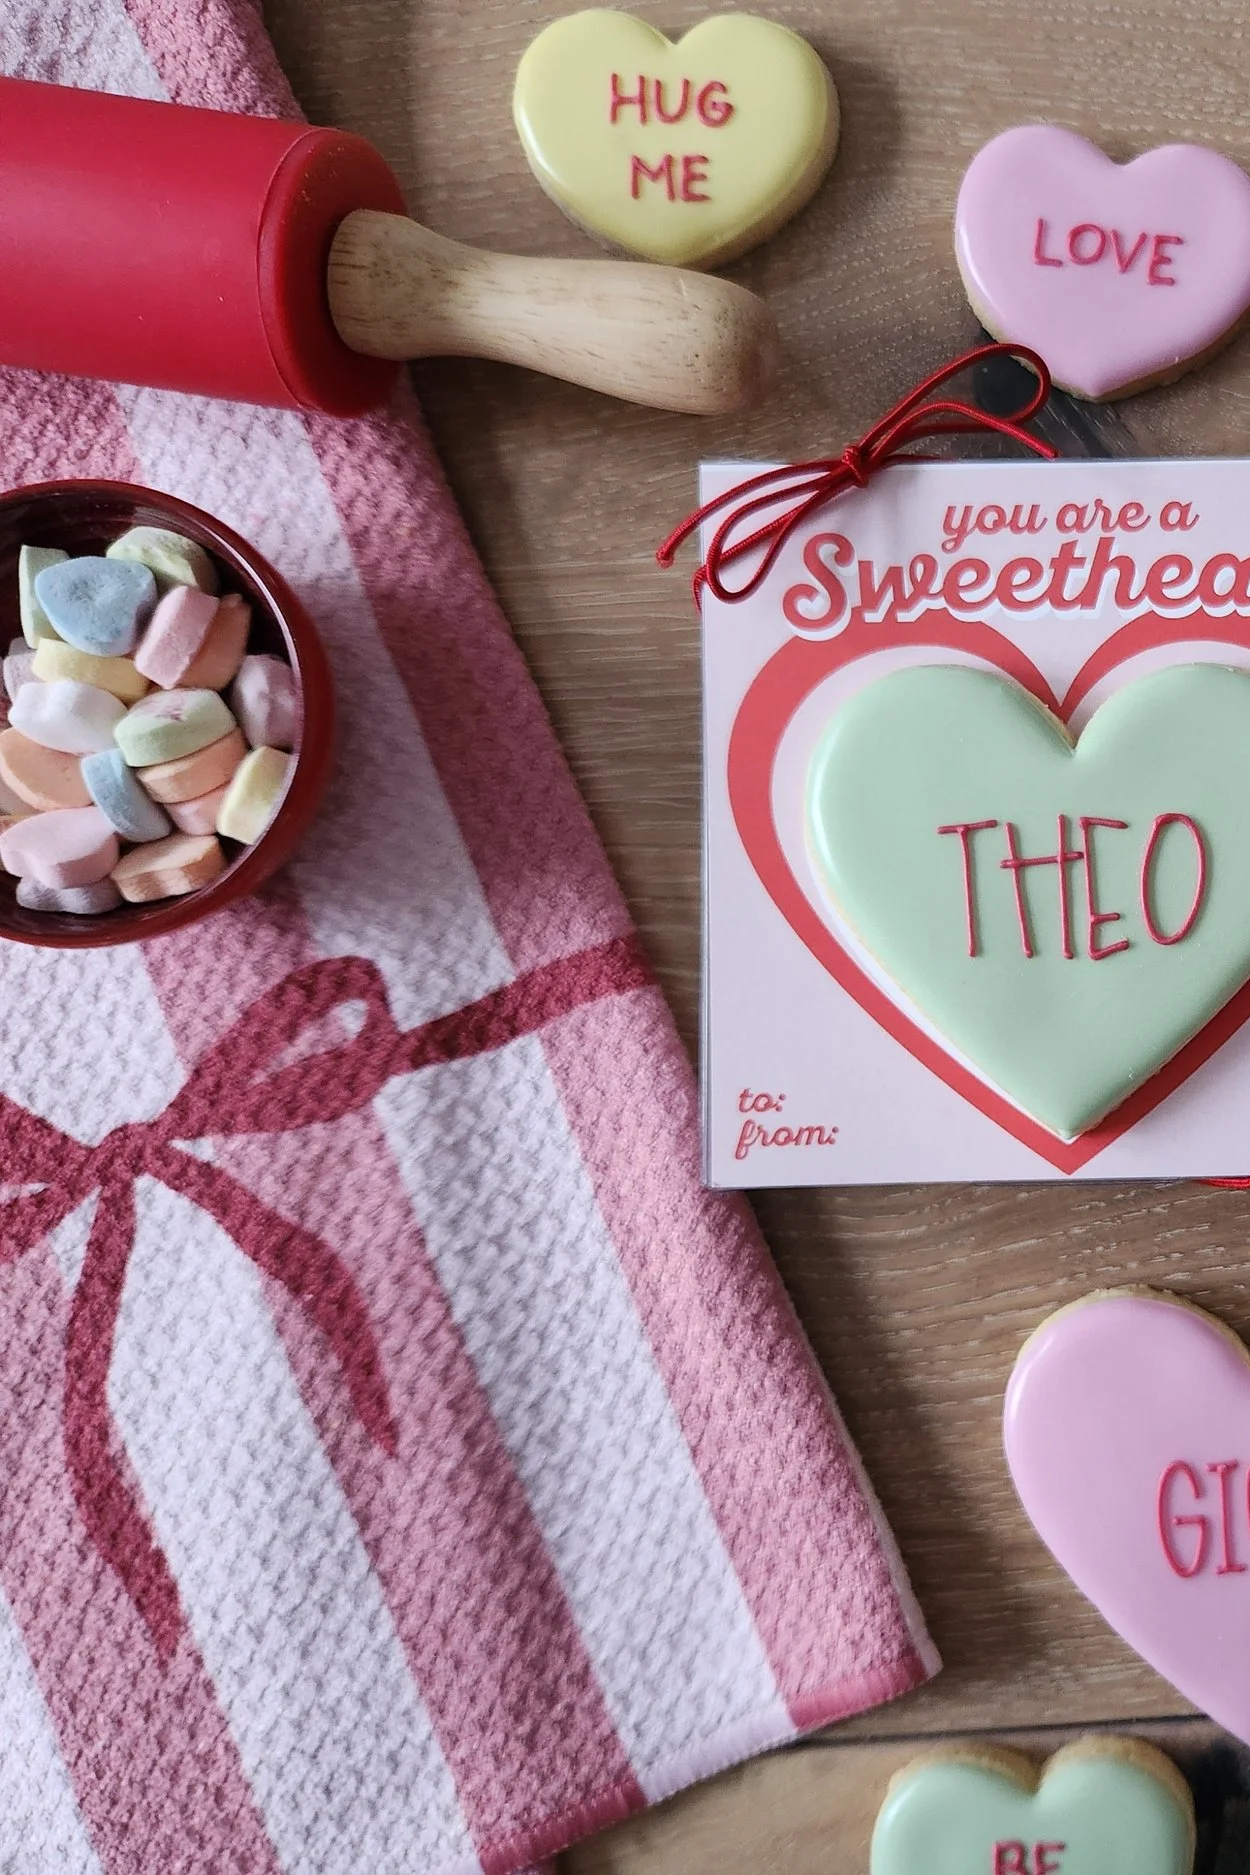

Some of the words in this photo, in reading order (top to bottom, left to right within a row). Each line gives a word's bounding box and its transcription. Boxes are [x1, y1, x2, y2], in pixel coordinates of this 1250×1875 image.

[608, 72, 735, 128] HUG
[629, 153, 712, 203] ME
[1032, 217, 1185, 287] LOVE
[941, 502, 1047, 553] you
[1055, 499, 1151, 534] are
[1159, 500, 1200, 532] a
[935, 811, 1209, 961] THEO
[738, 1087, 787, 1114] to:
[735, 1118, 840, 1161] from:
[991, 1838, 1066, 1875] BE
